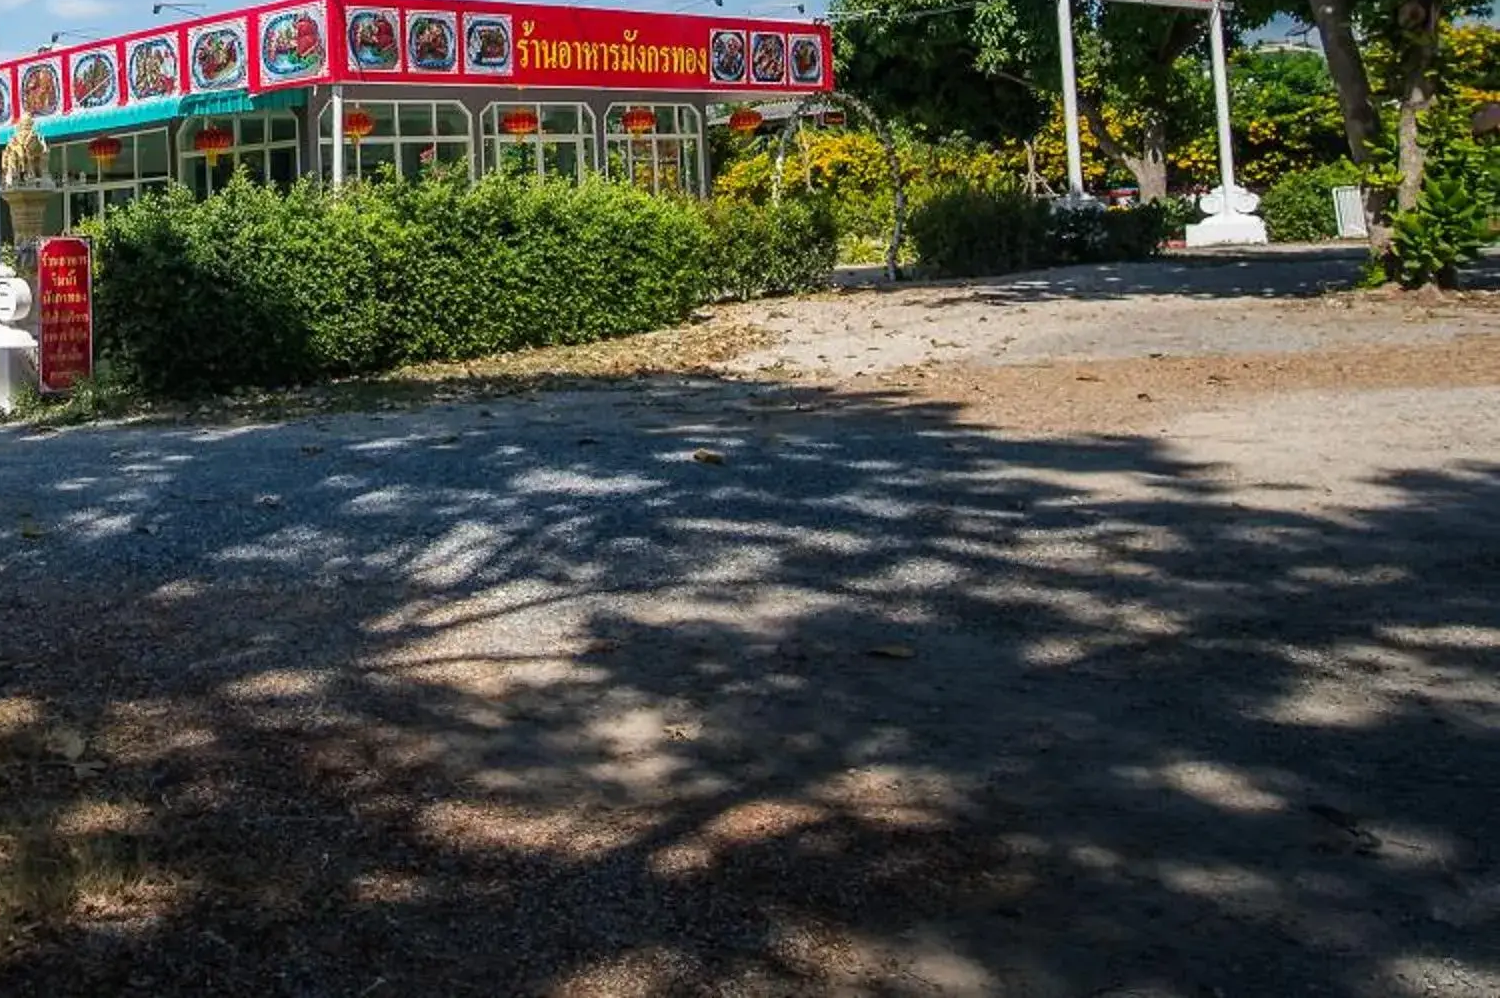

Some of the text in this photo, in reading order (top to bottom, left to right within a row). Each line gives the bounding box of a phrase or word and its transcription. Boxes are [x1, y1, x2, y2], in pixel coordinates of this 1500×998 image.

[517, 20, 707, 76] ร้านอาหารมังกรทอง
